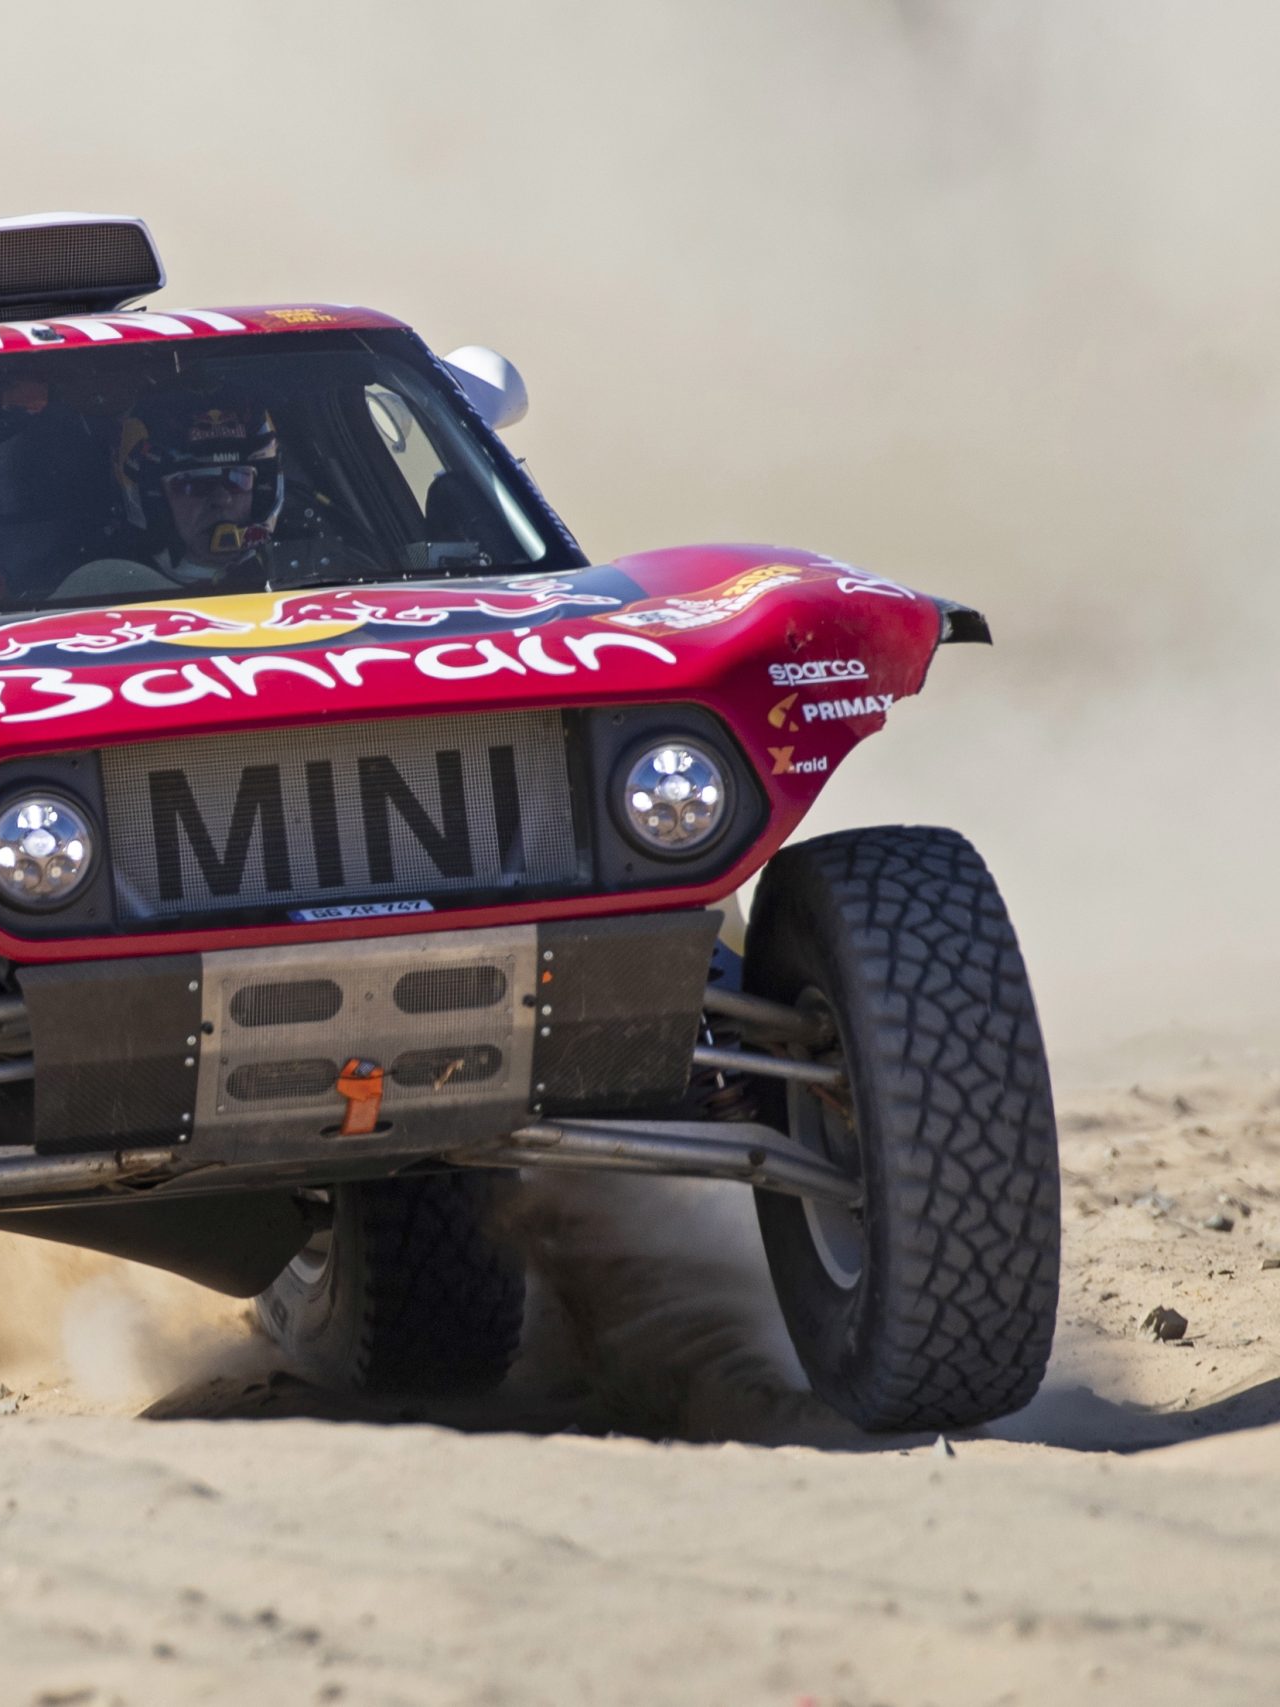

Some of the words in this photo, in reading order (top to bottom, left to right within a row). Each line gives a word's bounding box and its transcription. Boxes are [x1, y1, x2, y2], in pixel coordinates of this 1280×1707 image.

[768, 658, 869, 685] sparco
[803, 693, 895, 722] PRIMAX
[767, 745, 828, 775] X-raid
[145, 745, 527, 899] MINI
